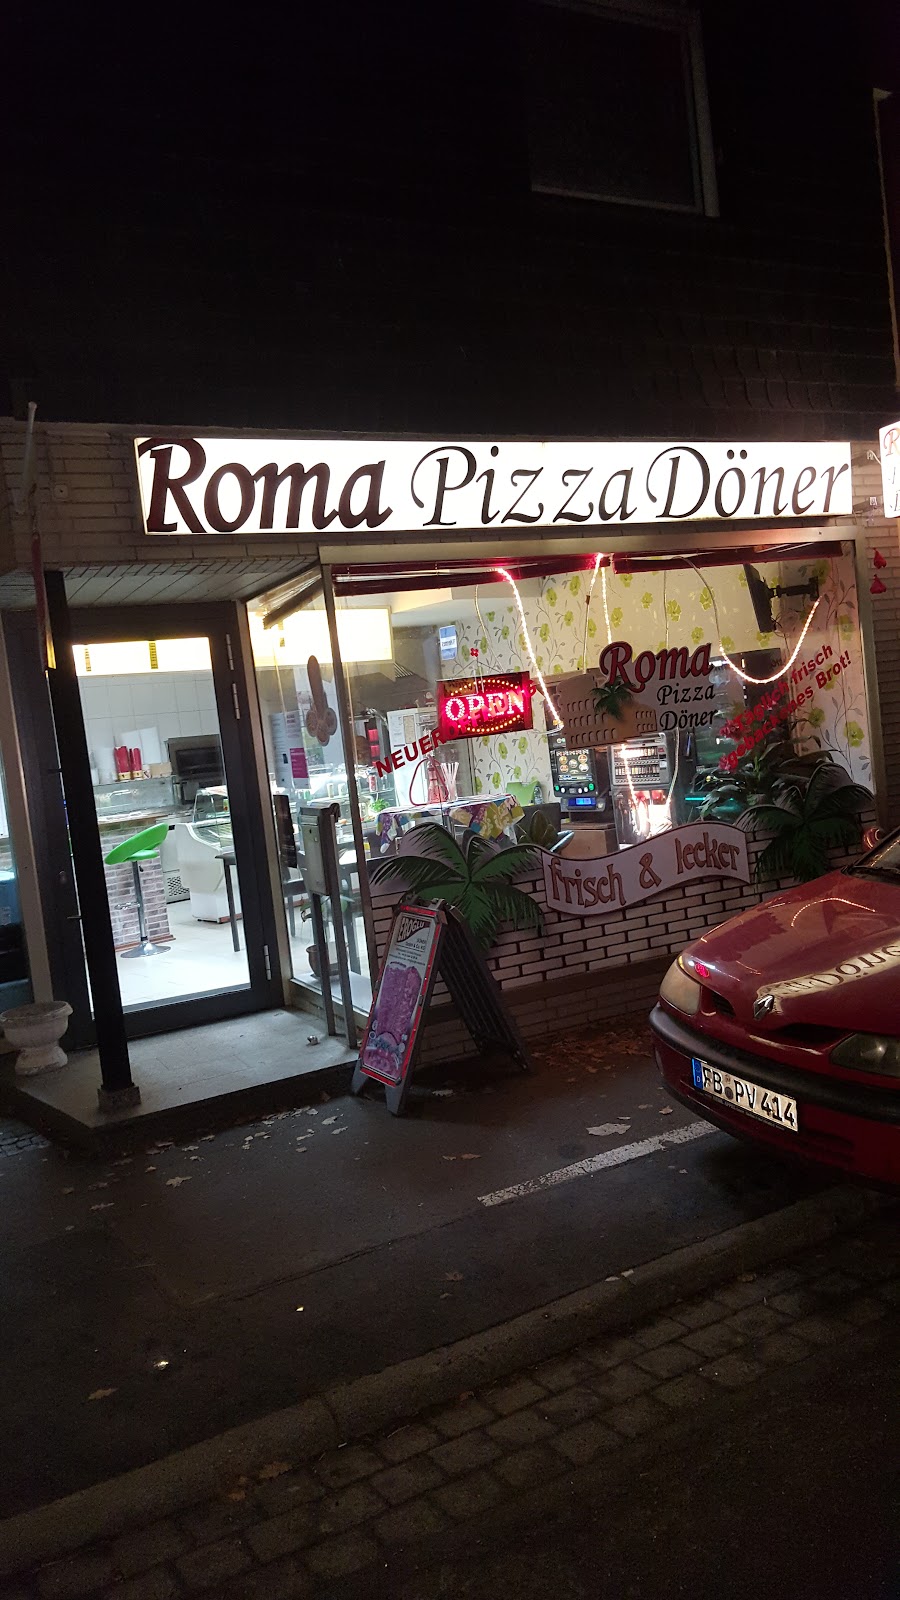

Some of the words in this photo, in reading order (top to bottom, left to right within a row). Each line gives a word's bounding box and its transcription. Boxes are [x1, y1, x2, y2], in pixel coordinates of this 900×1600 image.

[137, 436, 392, 535] Roma
[411, 445, 638, 526] Pizza
[646, 446, 851, 517] Döner
[599, 641, 715, 693] Roma
[791, 645, 834, 685] frisch
[815, 650, 852, 690] Brot!
[445, 690, 525, 721] OPEN
[657, 683, 716, 706] Pizza
[659, 709, 719, 731] Döner
[548, 857, 627, 908] frisch
[639, 852, 662, 889] &
[674, 832, 740, 874] lecker
[703, 1067, 722, 1094] FB
[734, 1080, 756, 1109] PV
[761, 1092, 795, 1127] 414
